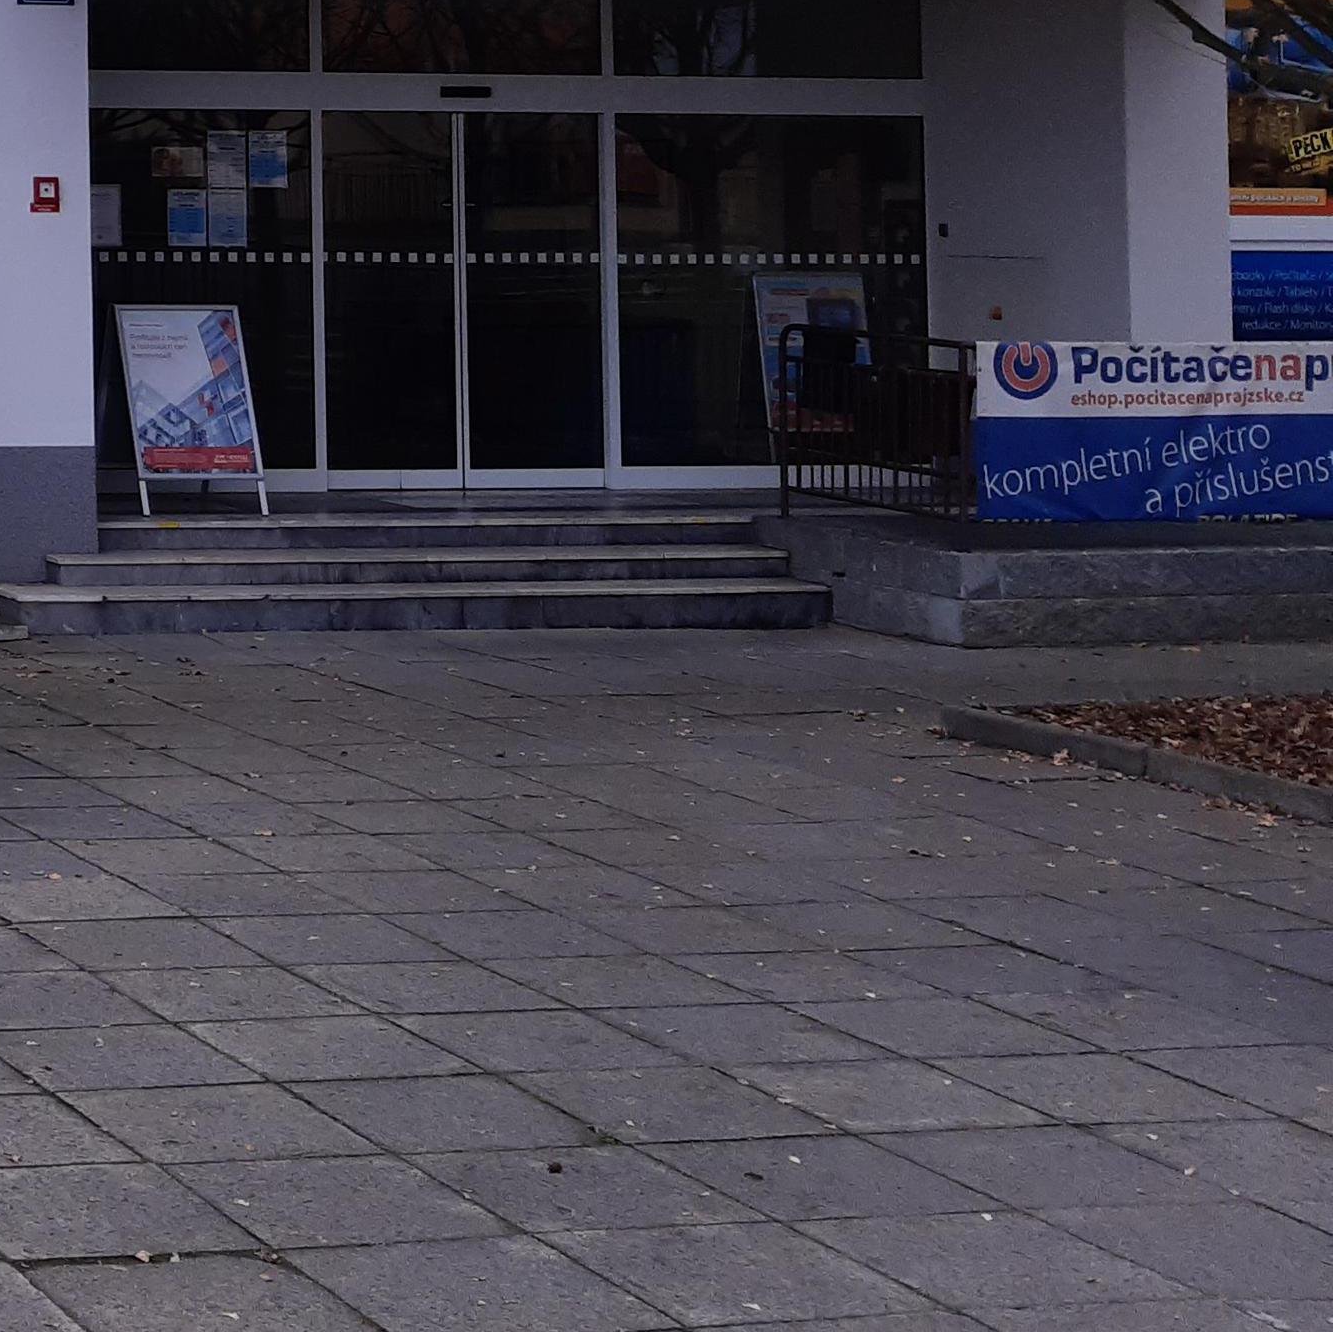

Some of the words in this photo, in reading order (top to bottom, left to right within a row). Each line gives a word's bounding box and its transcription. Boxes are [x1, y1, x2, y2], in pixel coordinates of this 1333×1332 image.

[1292, 131, 1333, 158] PECK
[1071, 388, 1304, 409] eshop.pocitacenaprajzske.cz
[983, 437, 1151, 500] kompletní
[1161, 424, 1271, 469] elektro
[1145, 488, 1163, 514] a
